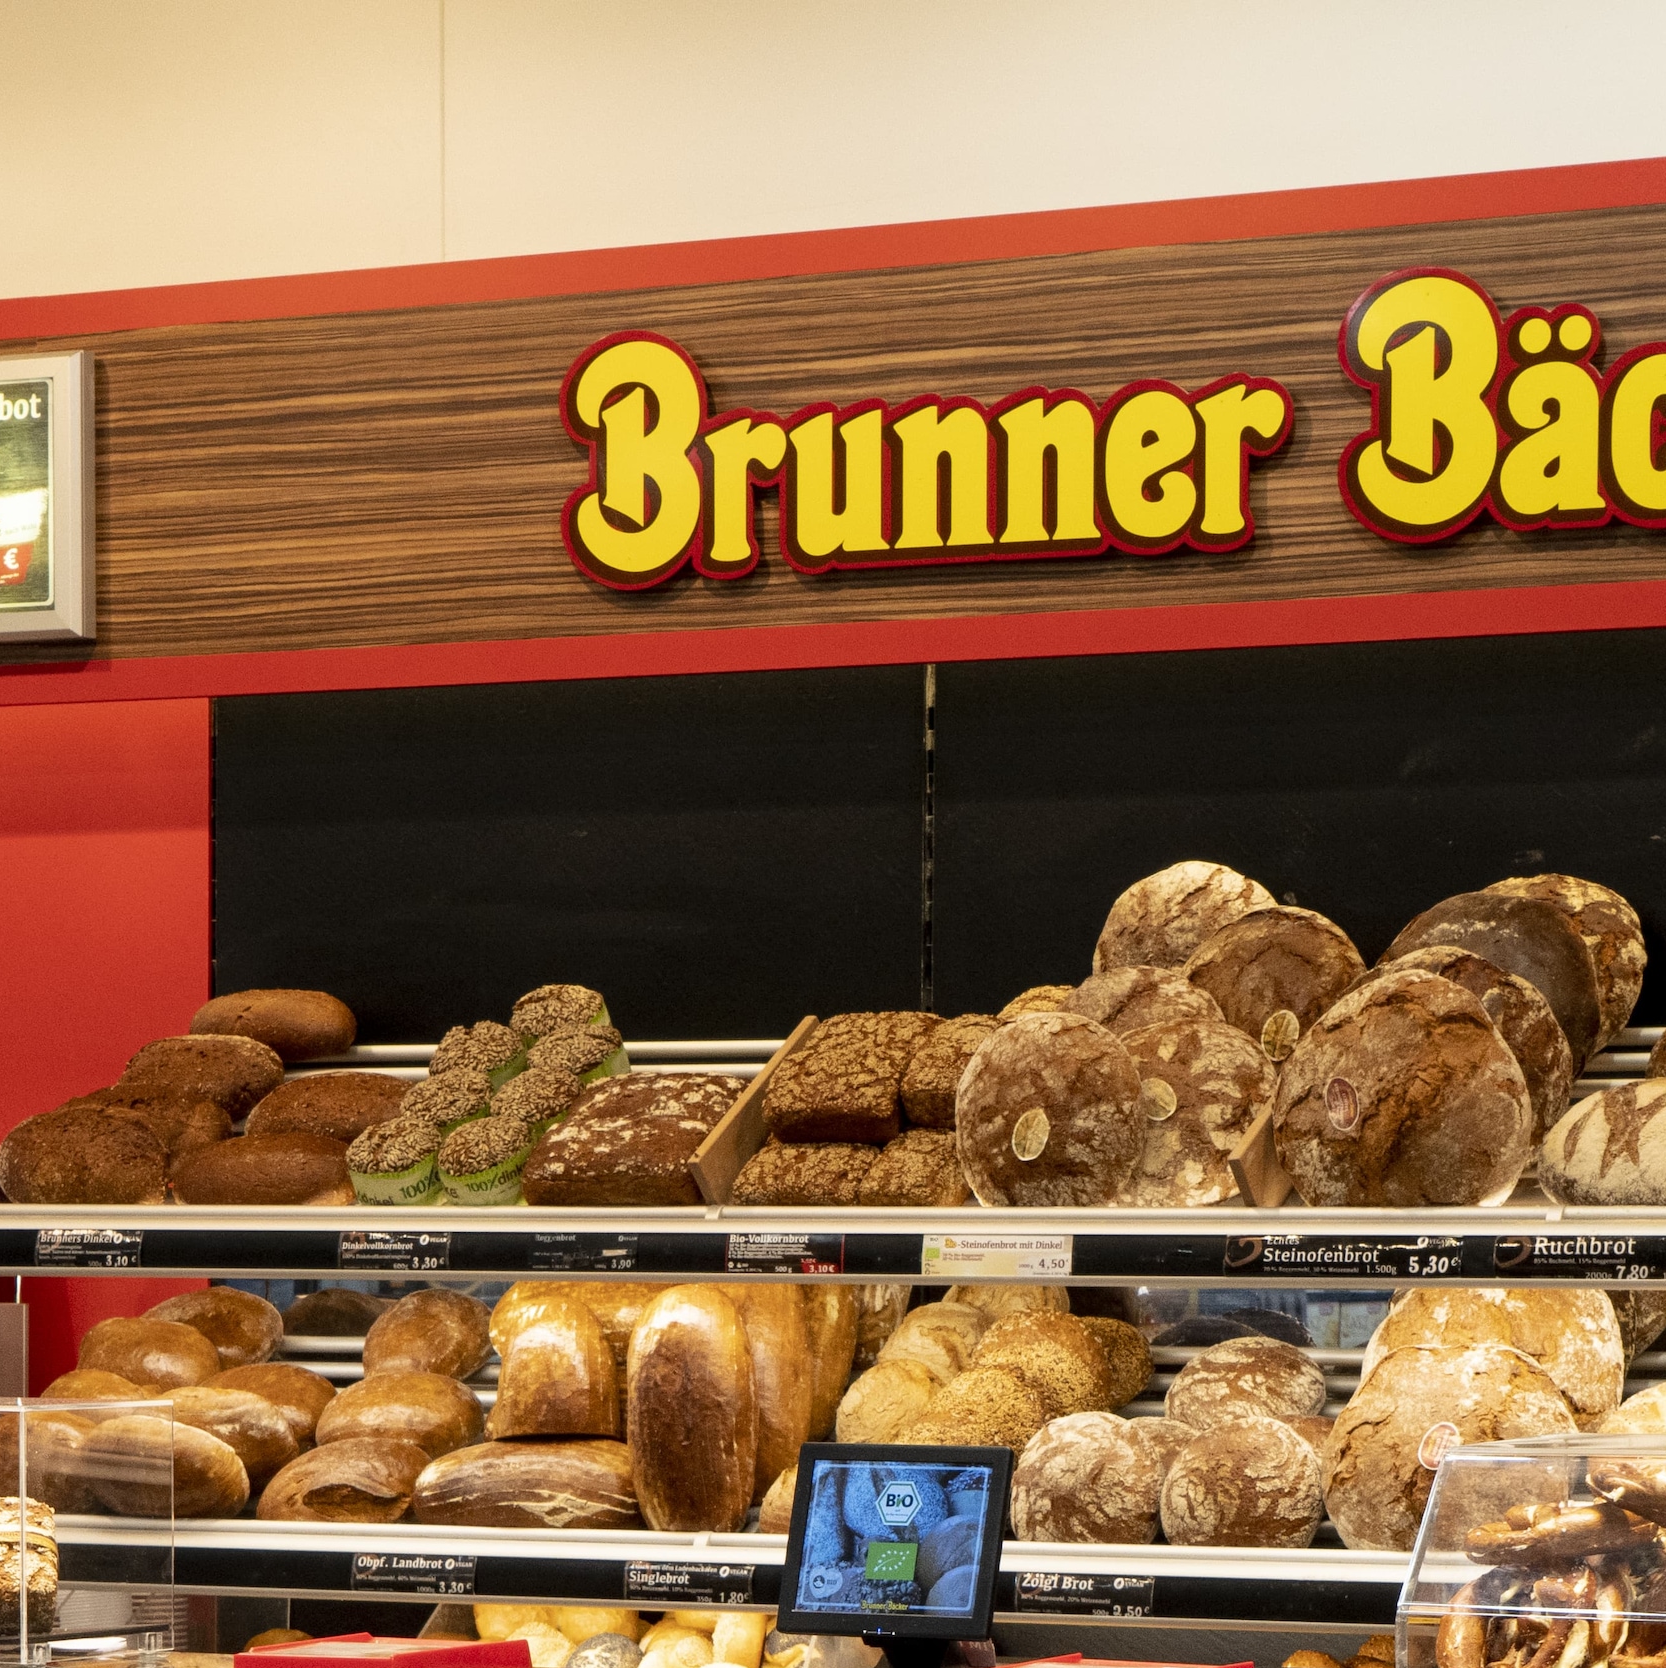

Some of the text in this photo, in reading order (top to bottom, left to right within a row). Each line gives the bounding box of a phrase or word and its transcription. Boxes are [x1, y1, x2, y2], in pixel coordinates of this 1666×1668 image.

[570, 335, 1287, 580] Brunner
[400, 1172, 434, 1199] 100%
[729, 1234, 809, 1244] Bio-Vollkornbrot
[1036, 1240, 1062, 1249] Dinkel
[1534, 1237, 1636, 1255] Ruchbrot
[1263, 1248, 1380, 1263] Steinofenbrot
[358, 1556, 442, 1569] Obpf. Landbrot
[629, 1571, 689, 1585] Singlebrot
[1062, 1576, 1094, 1590] Brot
